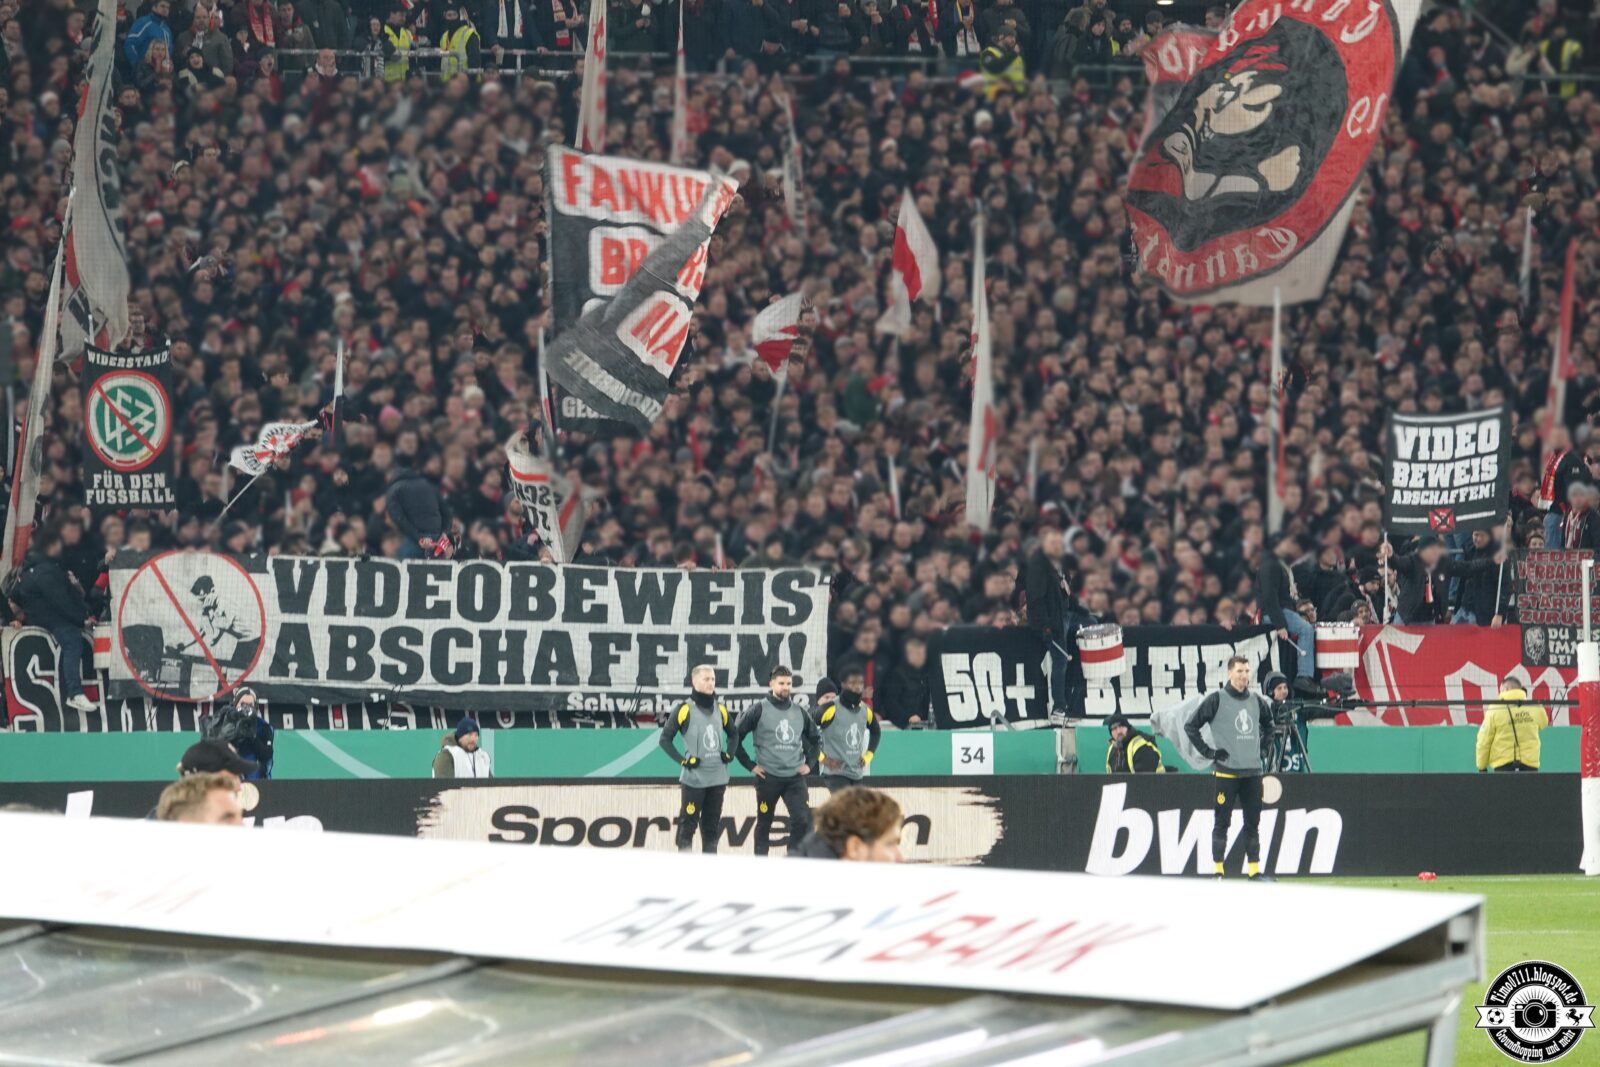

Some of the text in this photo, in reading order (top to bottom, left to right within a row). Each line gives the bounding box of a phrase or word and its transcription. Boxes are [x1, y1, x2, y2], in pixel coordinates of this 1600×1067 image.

[1393, 418, 1500, 461] VIDEO
[93, 470, 166, 489] FÜR DEN
[1391, 453, 1498, 488] BEWEIS
[86, 487, 175, 505] FUSSBALL
[1391, 481, 1496, 506] ABSCHAFFEN!
[271, 557, 816, 627] VIDEOBEWEIS
[1548, 627, 1569, 640] DU
[269, 623, 808, 688] ABSCHAFFEN!
[960, 746, 985, 764] 34
